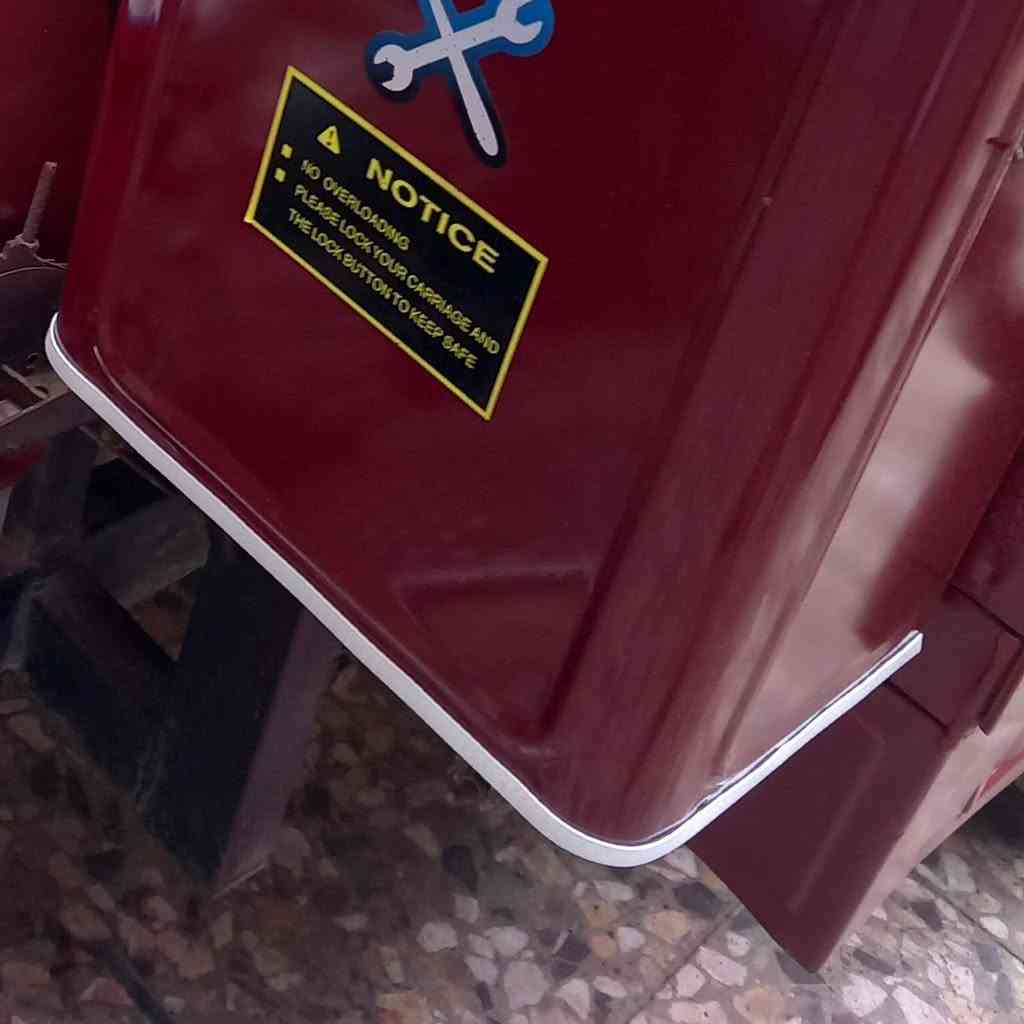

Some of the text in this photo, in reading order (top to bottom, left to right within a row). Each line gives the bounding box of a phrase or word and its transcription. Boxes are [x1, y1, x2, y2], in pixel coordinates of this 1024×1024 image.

[294, 184, 501, 354] PLEASE LOCK YOUR CARRIAGE AND
[300, 159, 411, 251] NO OVERLOADING
[366, 157, 500, 274] NOTICE
[288, 207, 478, 369] THE LOCK BUTTON TO KEEP SAFE
